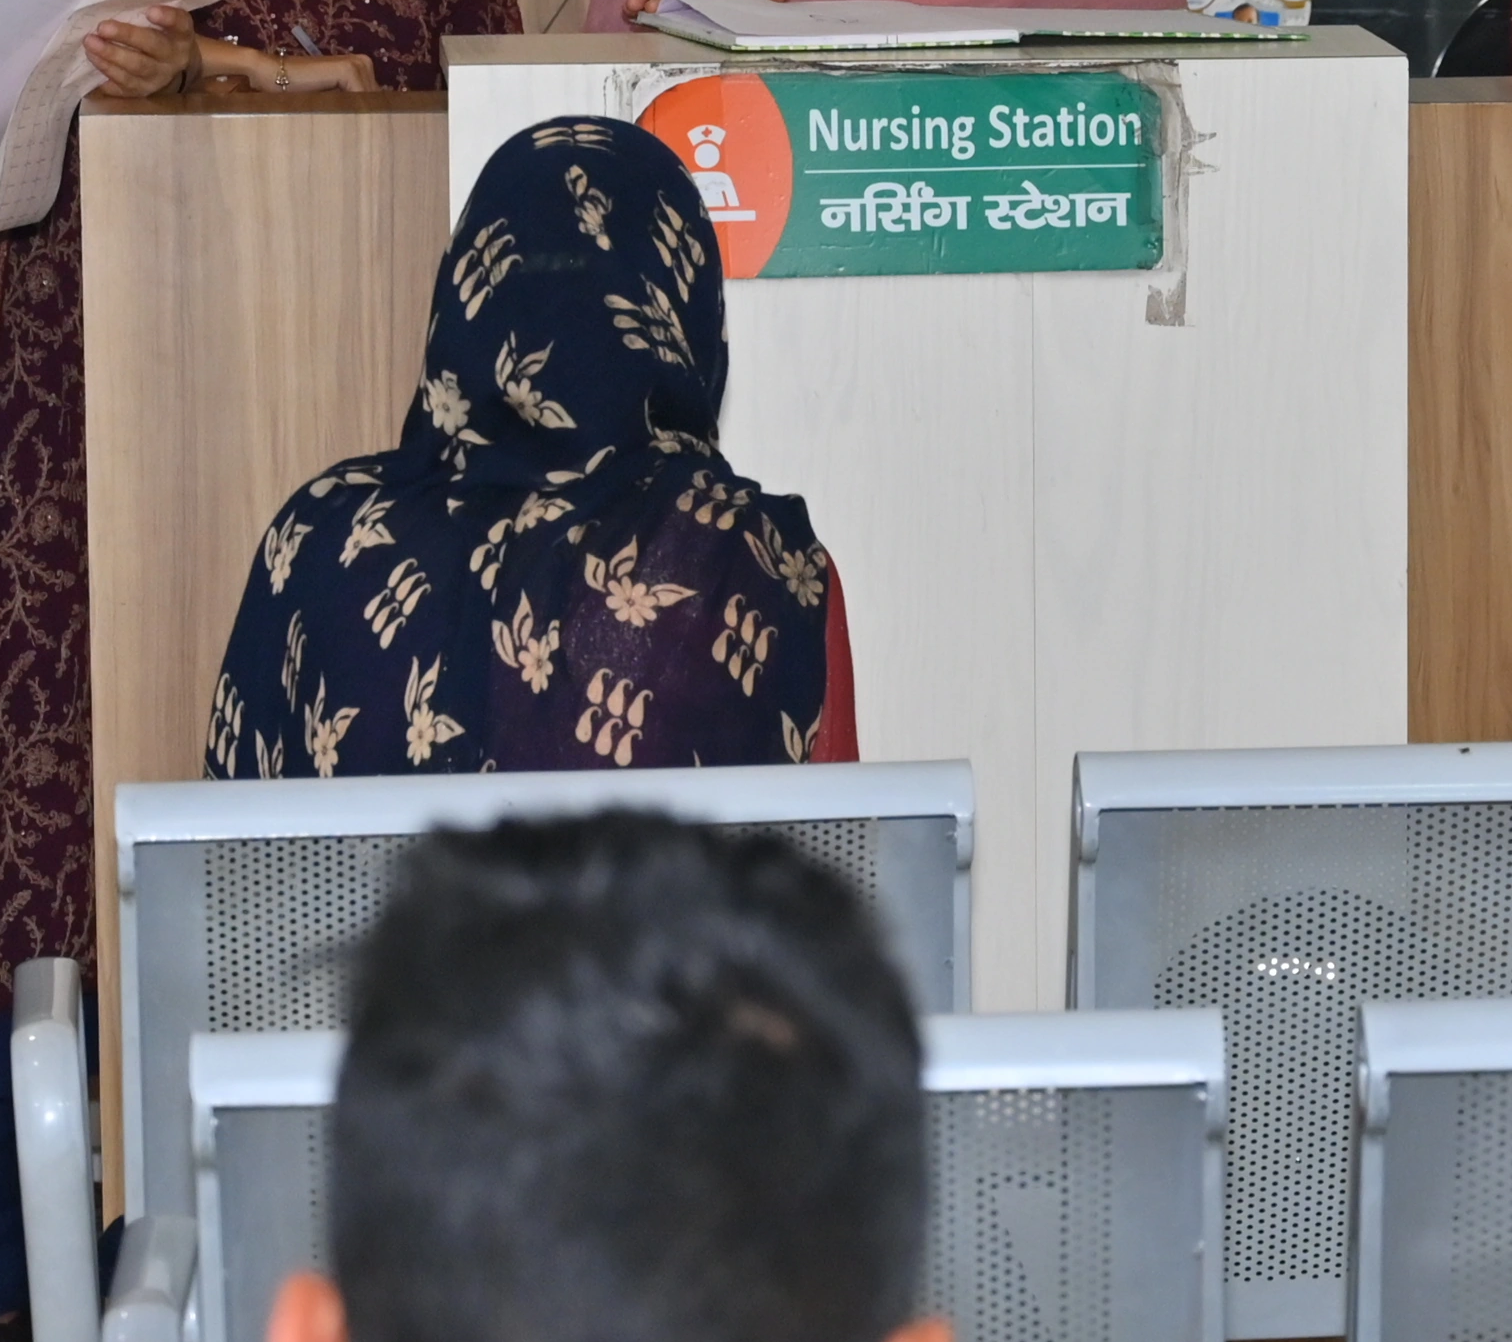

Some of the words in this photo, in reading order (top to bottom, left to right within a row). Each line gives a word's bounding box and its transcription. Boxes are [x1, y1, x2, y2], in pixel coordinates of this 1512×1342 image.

[808, 106, 976, 160] Nursing
[987, 102, 1142, 148] Station
[820, 182, 971, 234] नर्सिंग
[983, 180, 1131, 231] स्टेशन
